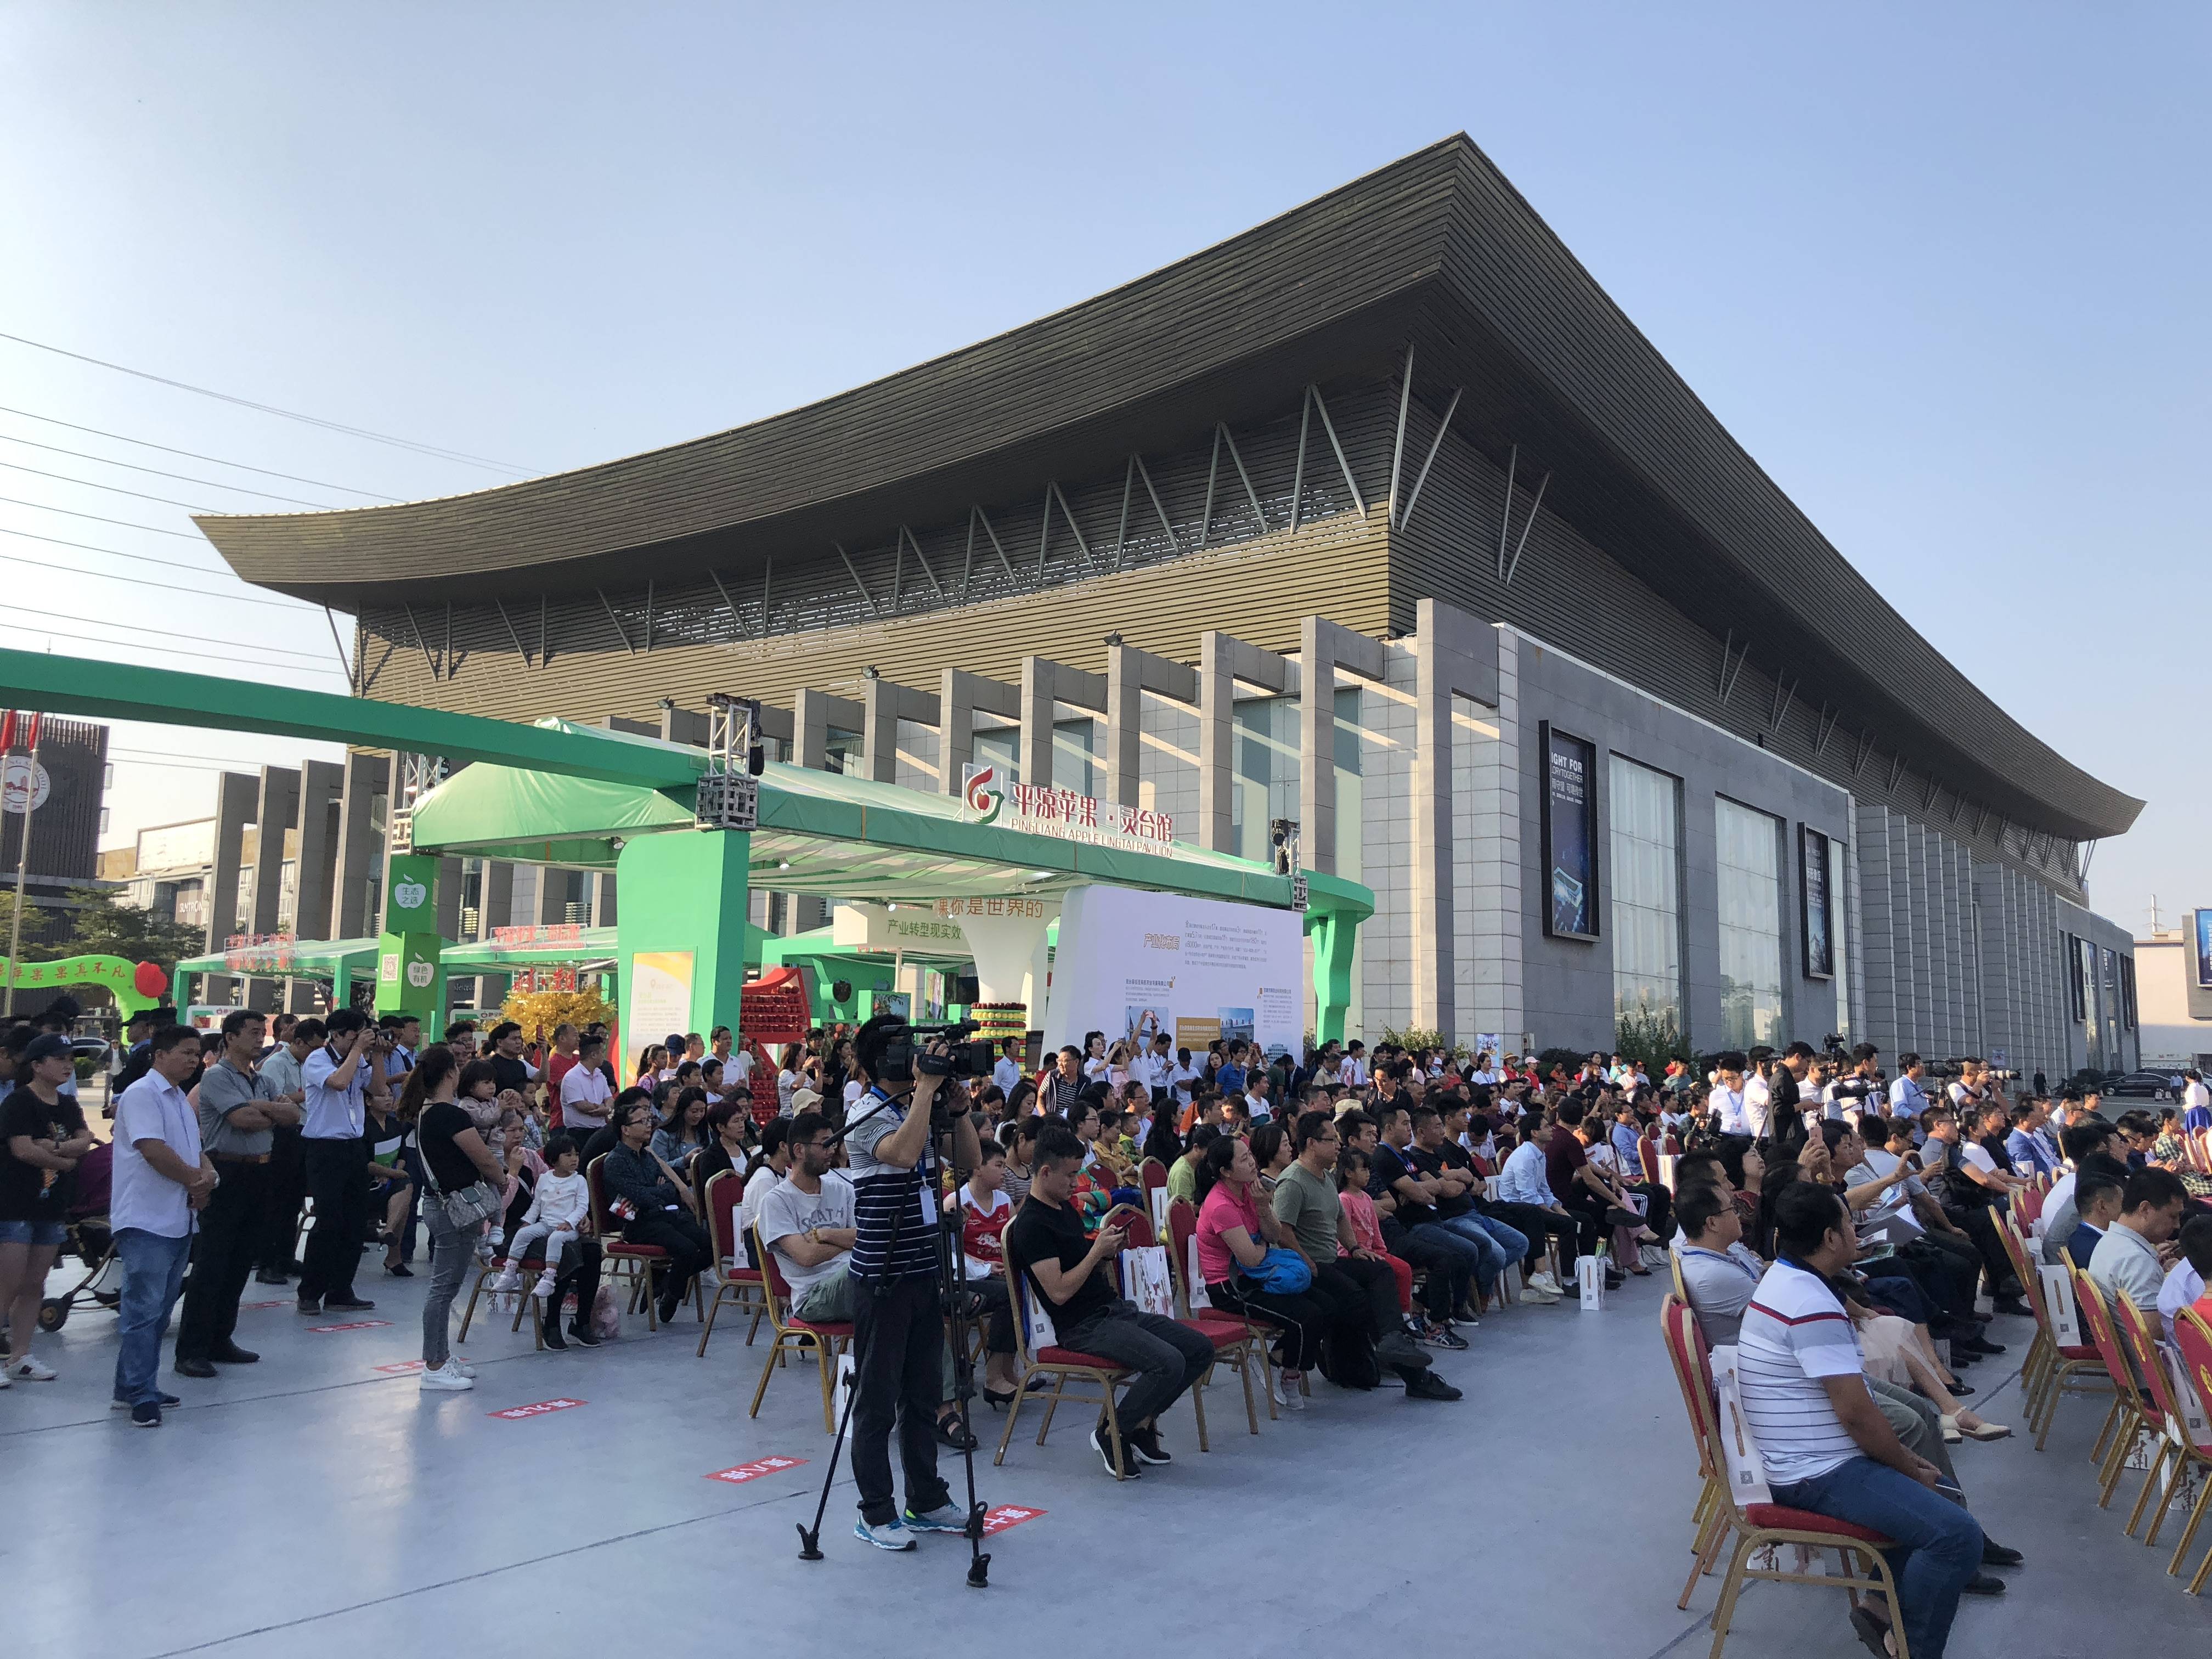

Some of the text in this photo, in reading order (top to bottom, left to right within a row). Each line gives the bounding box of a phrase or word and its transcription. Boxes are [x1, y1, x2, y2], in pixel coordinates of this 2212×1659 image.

[1570, 758, 1582, 773] FOR
[1011, 817, 1173, 857] PINGLIANG APPLE LINGTAI PAVILION
[1143, 933, 1180, 950] 产业化布局
[54, 961, 126, 978] 果真不凡
